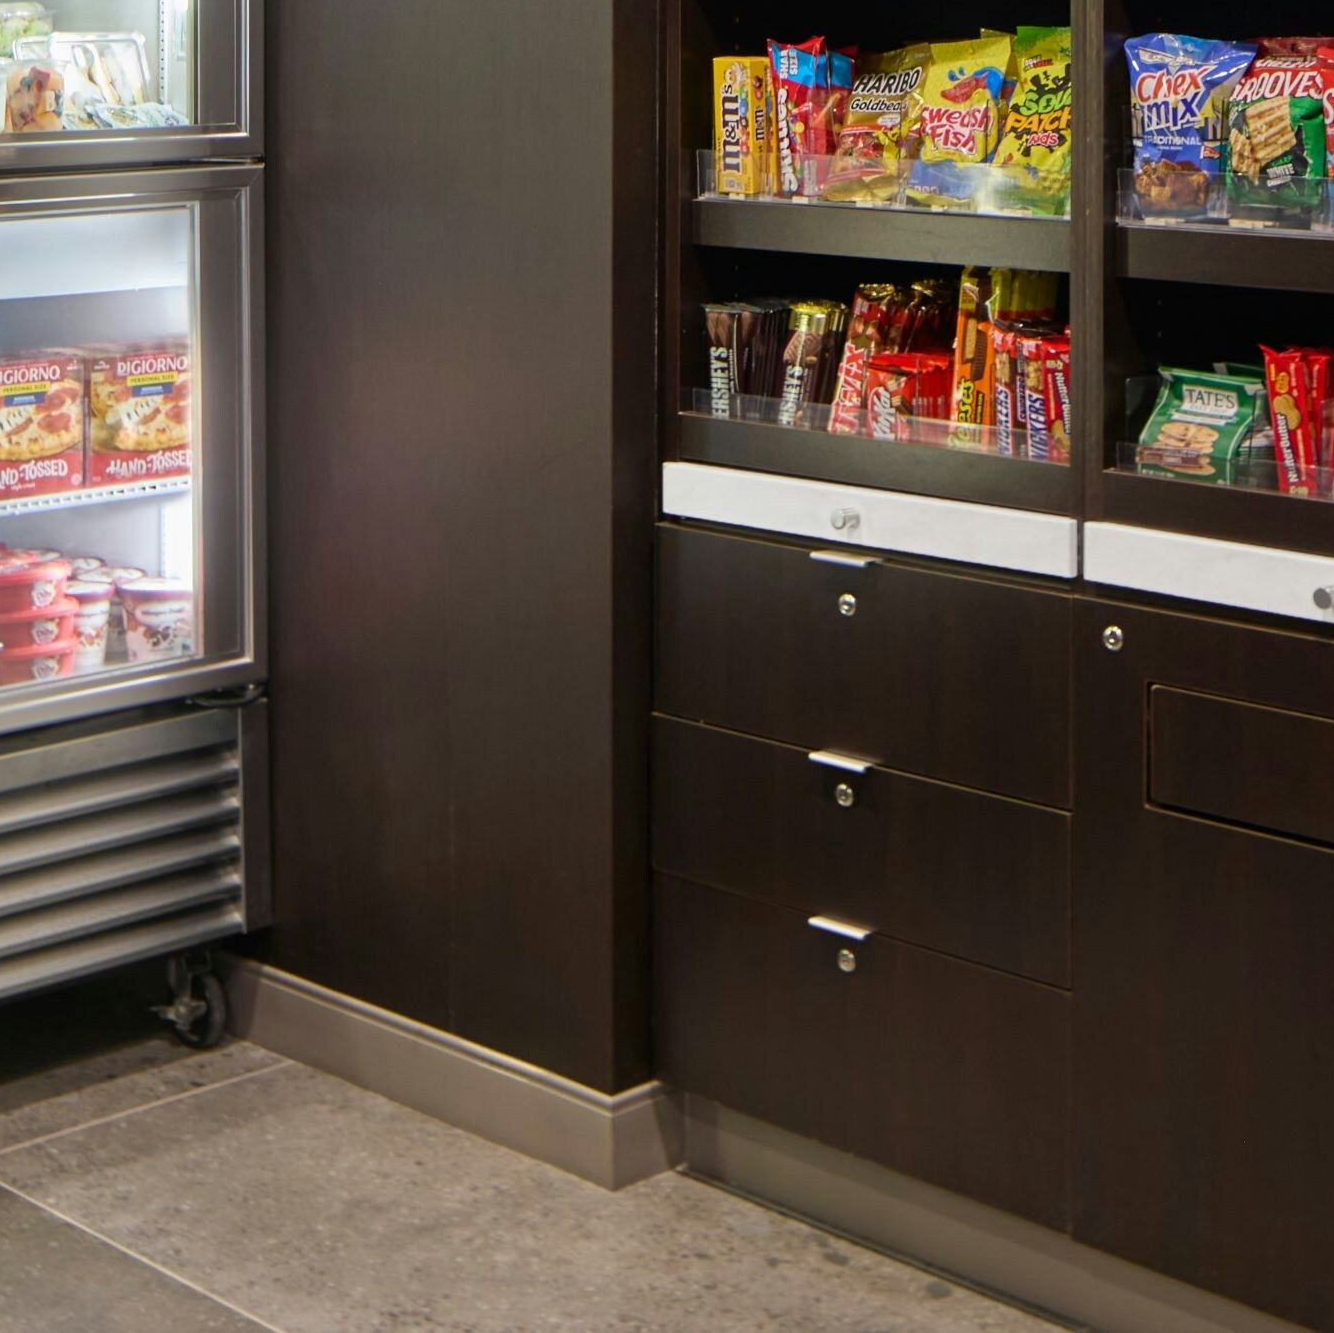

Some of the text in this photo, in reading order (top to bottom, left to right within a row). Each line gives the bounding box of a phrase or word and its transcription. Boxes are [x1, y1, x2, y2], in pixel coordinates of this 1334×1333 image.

[853, 68, 922, 95] HARIBO
[1137, 67, 1210, 103] Chex
[1144, 135, 1203, 147] TRADITIONAL
[117, 356, 191, 377] DIGIORNO
[710, 346, 730, 420] ERSHEY'S
[1185, 388, 1237, 410] TATE'S
